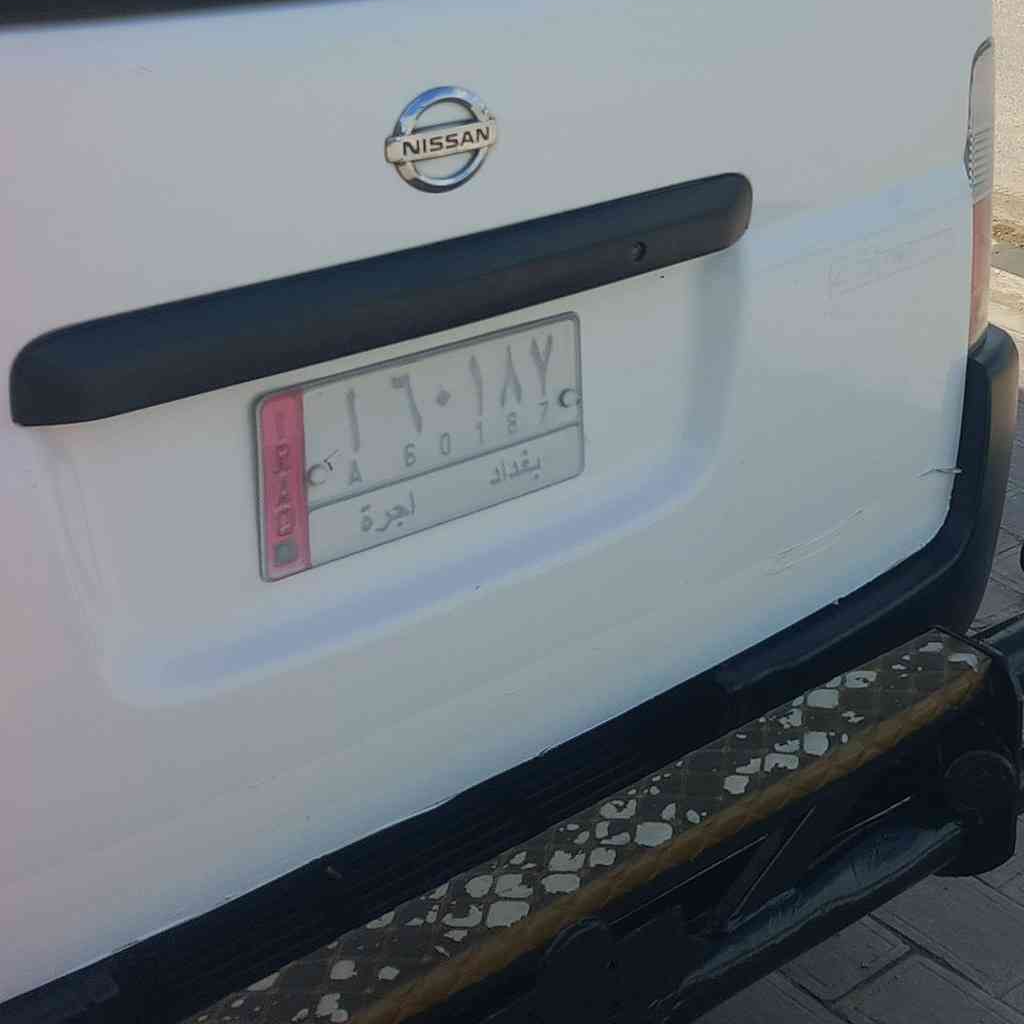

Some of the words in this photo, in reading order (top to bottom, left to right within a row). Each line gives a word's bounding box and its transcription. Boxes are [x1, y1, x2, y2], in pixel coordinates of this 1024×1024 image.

[402, 126, 490, 156] NISSAN
[391, 335, 554, 434] ٦٠١٨٧
[348, 460, 364, 486] A
[403, 401, 550, 468] 60187
[489, 449, 543, 486] بغداد
[360, 490, 417, 534] اجرة
